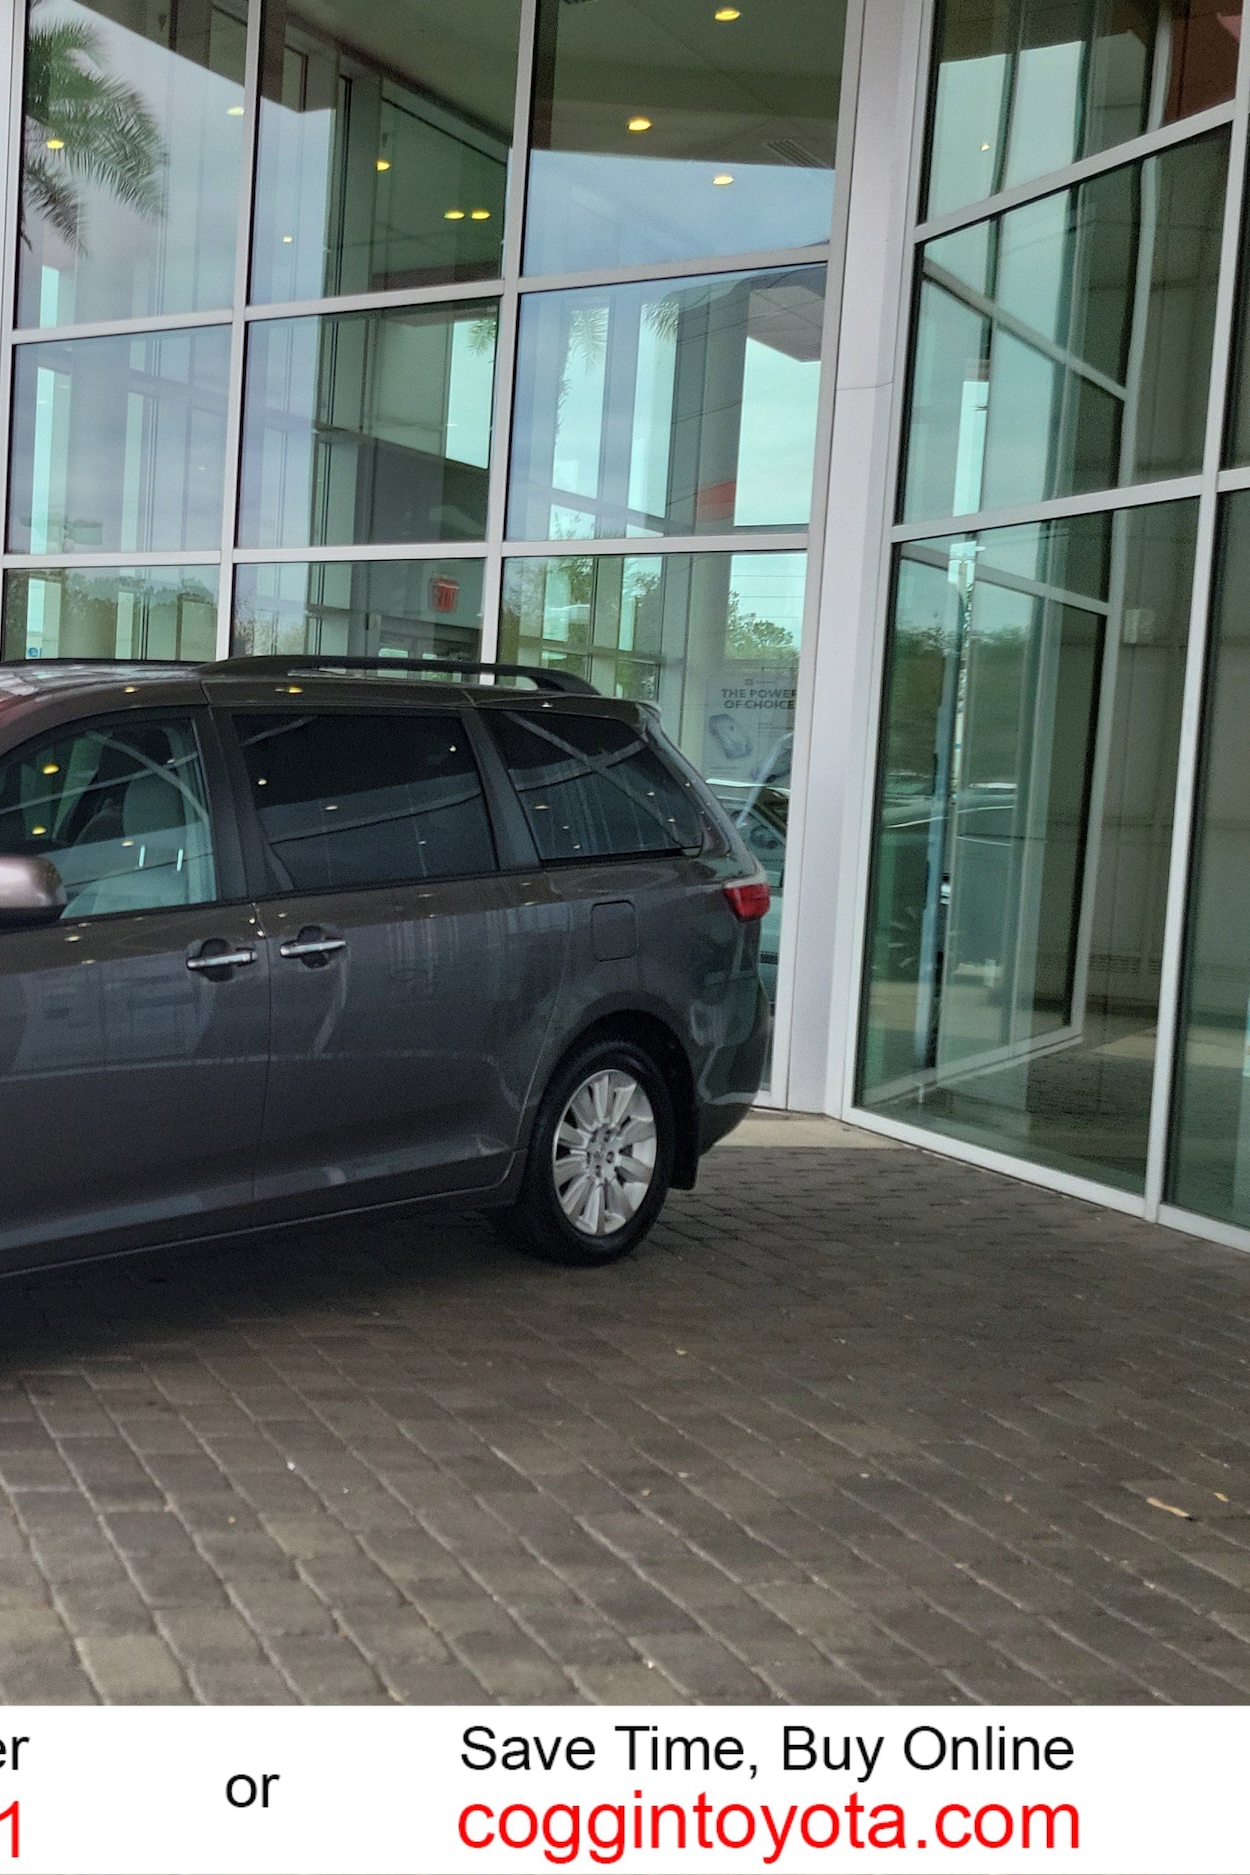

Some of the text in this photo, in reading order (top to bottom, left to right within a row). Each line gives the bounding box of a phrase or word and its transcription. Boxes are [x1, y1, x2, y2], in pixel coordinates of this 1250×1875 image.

[721, 688, 746, 699] THE
[724, 699, 795, 710] OF CHOICE
